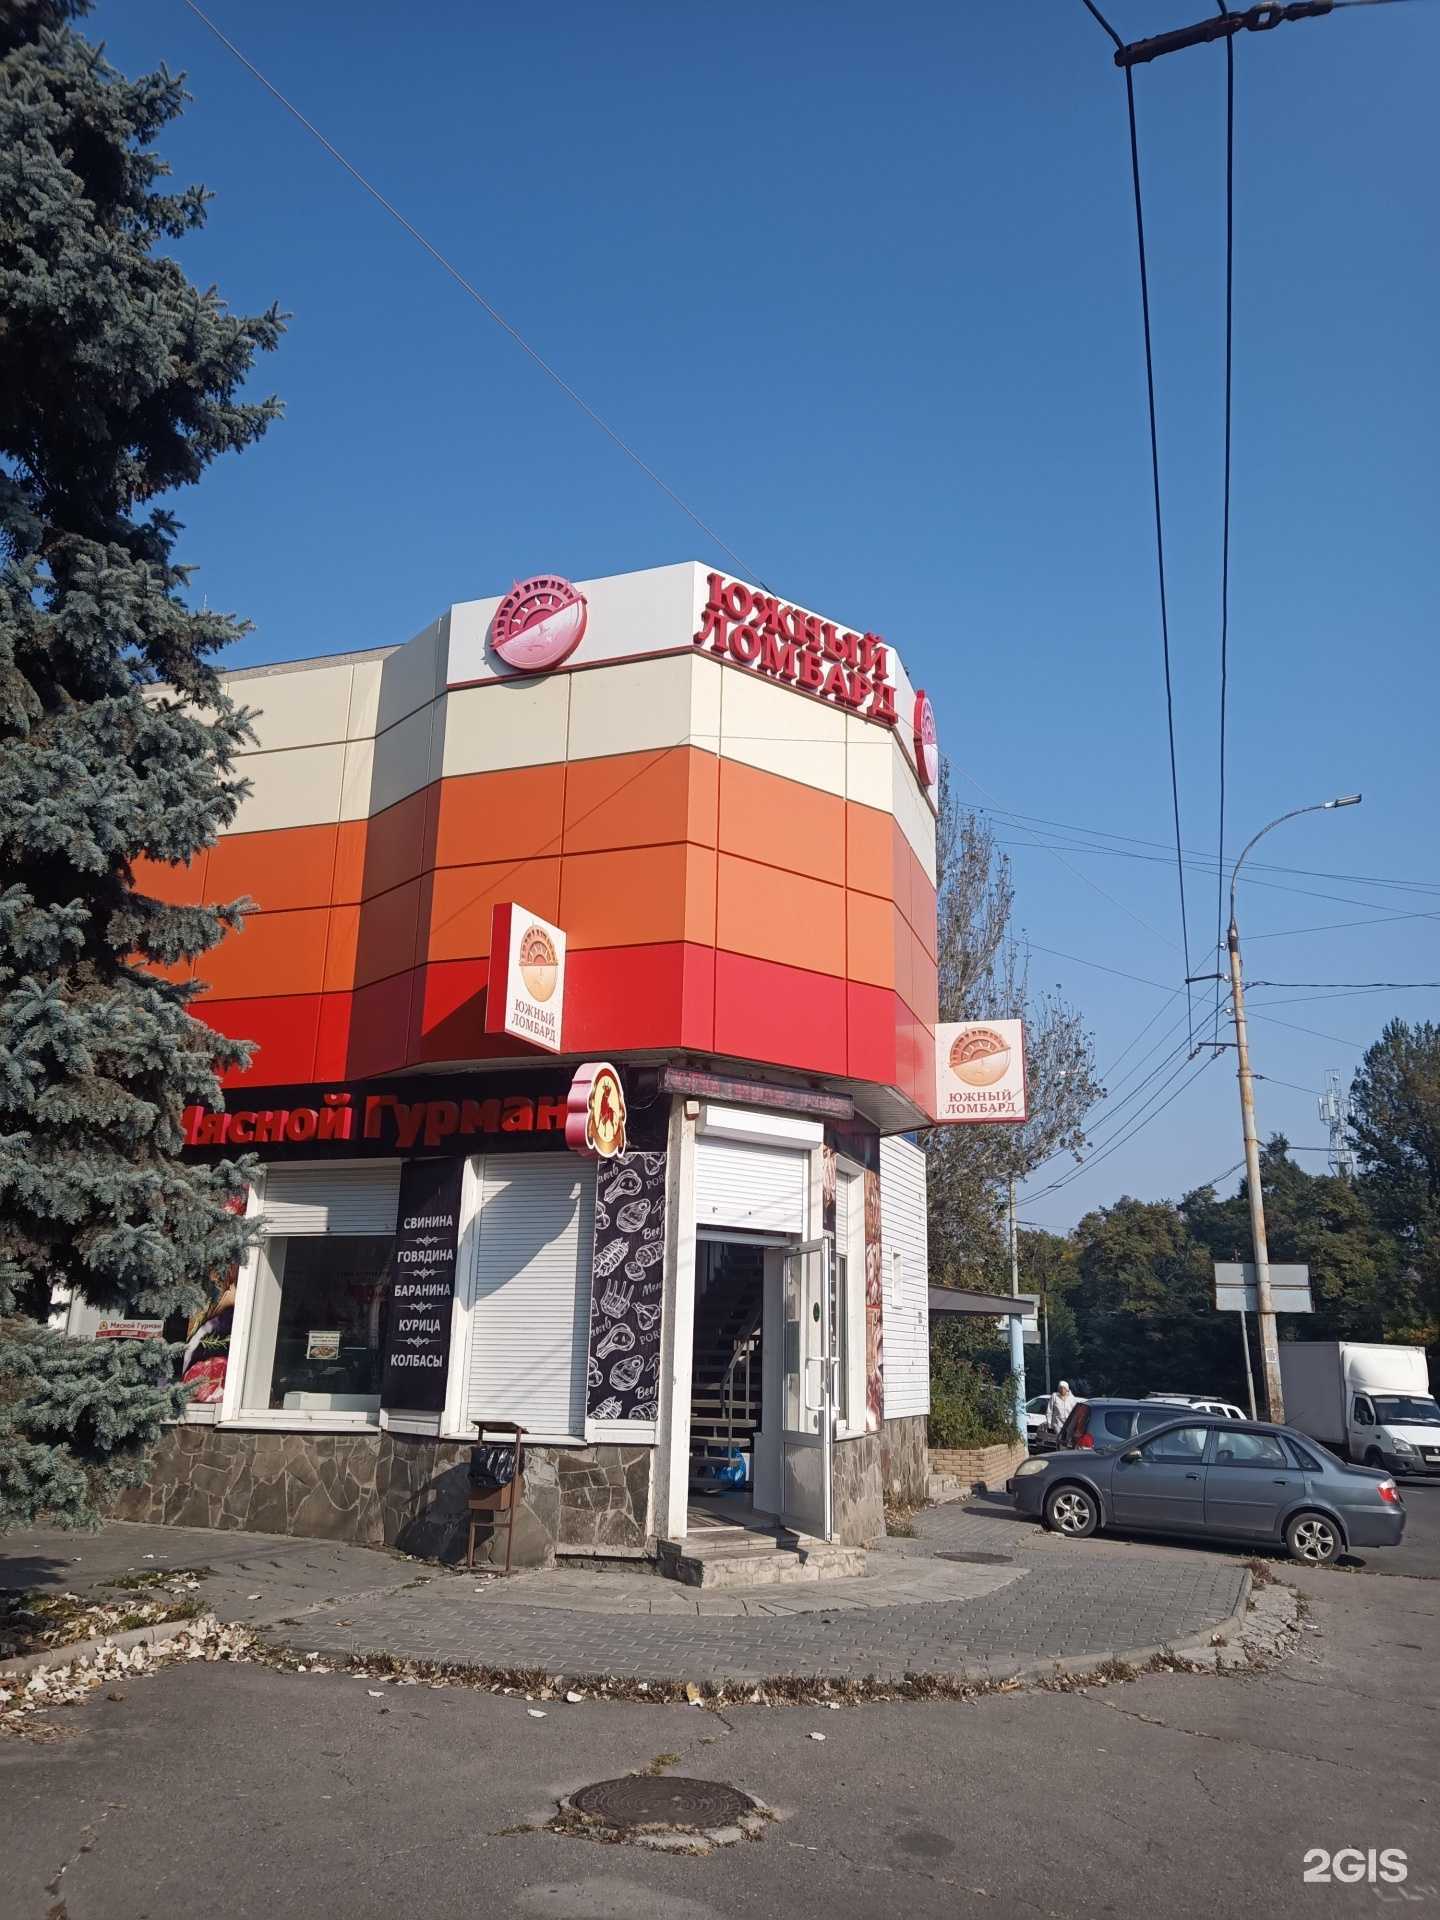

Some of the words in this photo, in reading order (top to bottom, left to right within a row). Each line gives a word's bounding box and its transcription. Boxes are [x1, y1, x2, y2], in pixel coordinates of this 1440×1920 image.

[706, 572, 889, 680] ЮЖНЫЙ
[693, 609, 898, 724] ЛОМБАРД
[514, 998, 556, 1027] ЮЖНЫЙ
[511, 1013, 556, 1042] ЛОМБАРД
[949, 1088, 1012, 1102] ЮЖНЫЙ
[945, 1102, 1017, 1114] ЛОМБАРД
[364, 1094, 567, 1147] Гурман
[403, 1215, 453, 1229] СВИНИНА
[397, 1249, 453, 1264] ГОВЯДИНА
[394, 1284, 451, 1297] БАРАНИНА
[398, 1319, 441, 1334] КУРИЦА
[390, 1354, 443, 1368] КОЛБАСЫ
